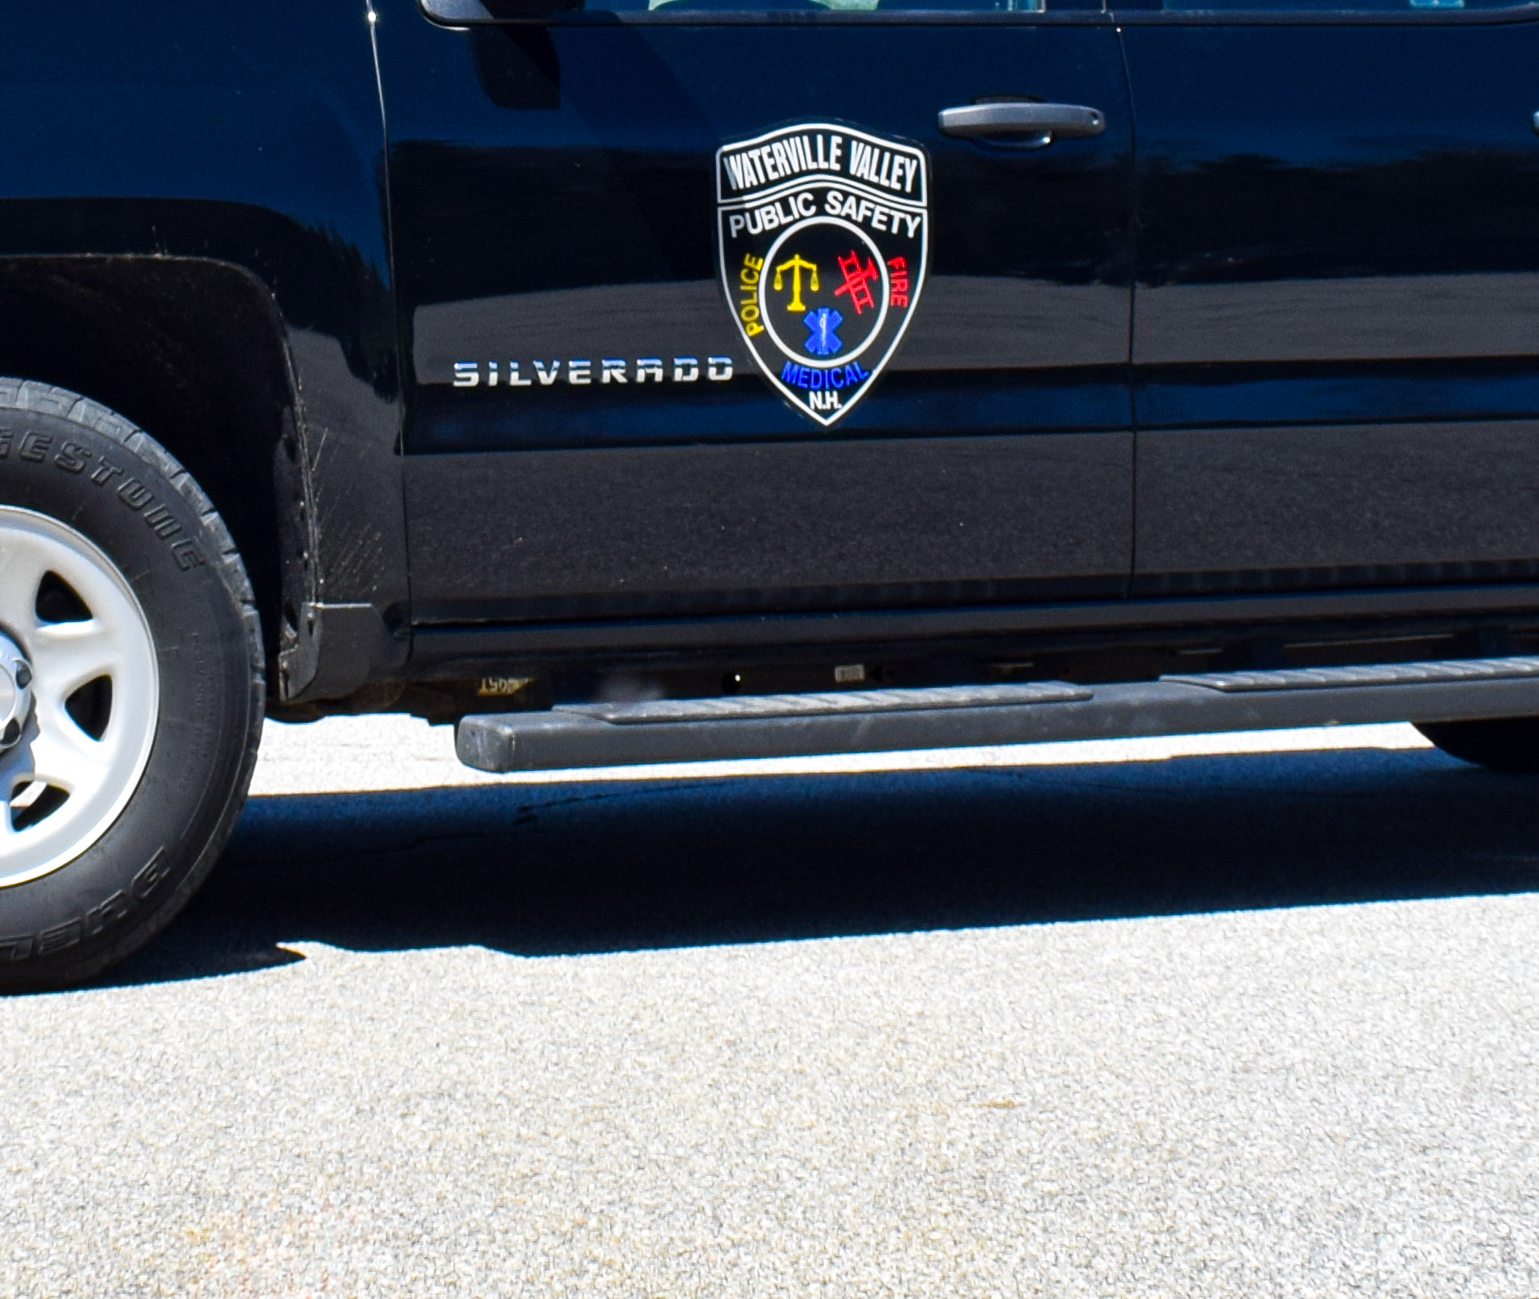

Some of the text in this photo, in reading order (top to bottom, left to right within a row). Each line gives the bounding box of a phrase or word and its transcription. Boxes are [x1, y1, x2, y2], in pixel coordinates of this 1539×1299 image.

[723, 134, 917, 193] WATERVILLE VALLEY
[728, 191, 921, 238] PUBLIC SAFETY
[739, 253, 764, 337] POLICE
[887, 256, 909, 308] FIRE
[453, 355, 734, 388] SILVERADO
[781, 361, 870, 389] MEDICAL
[808, 391, 843, 410] N.H.
